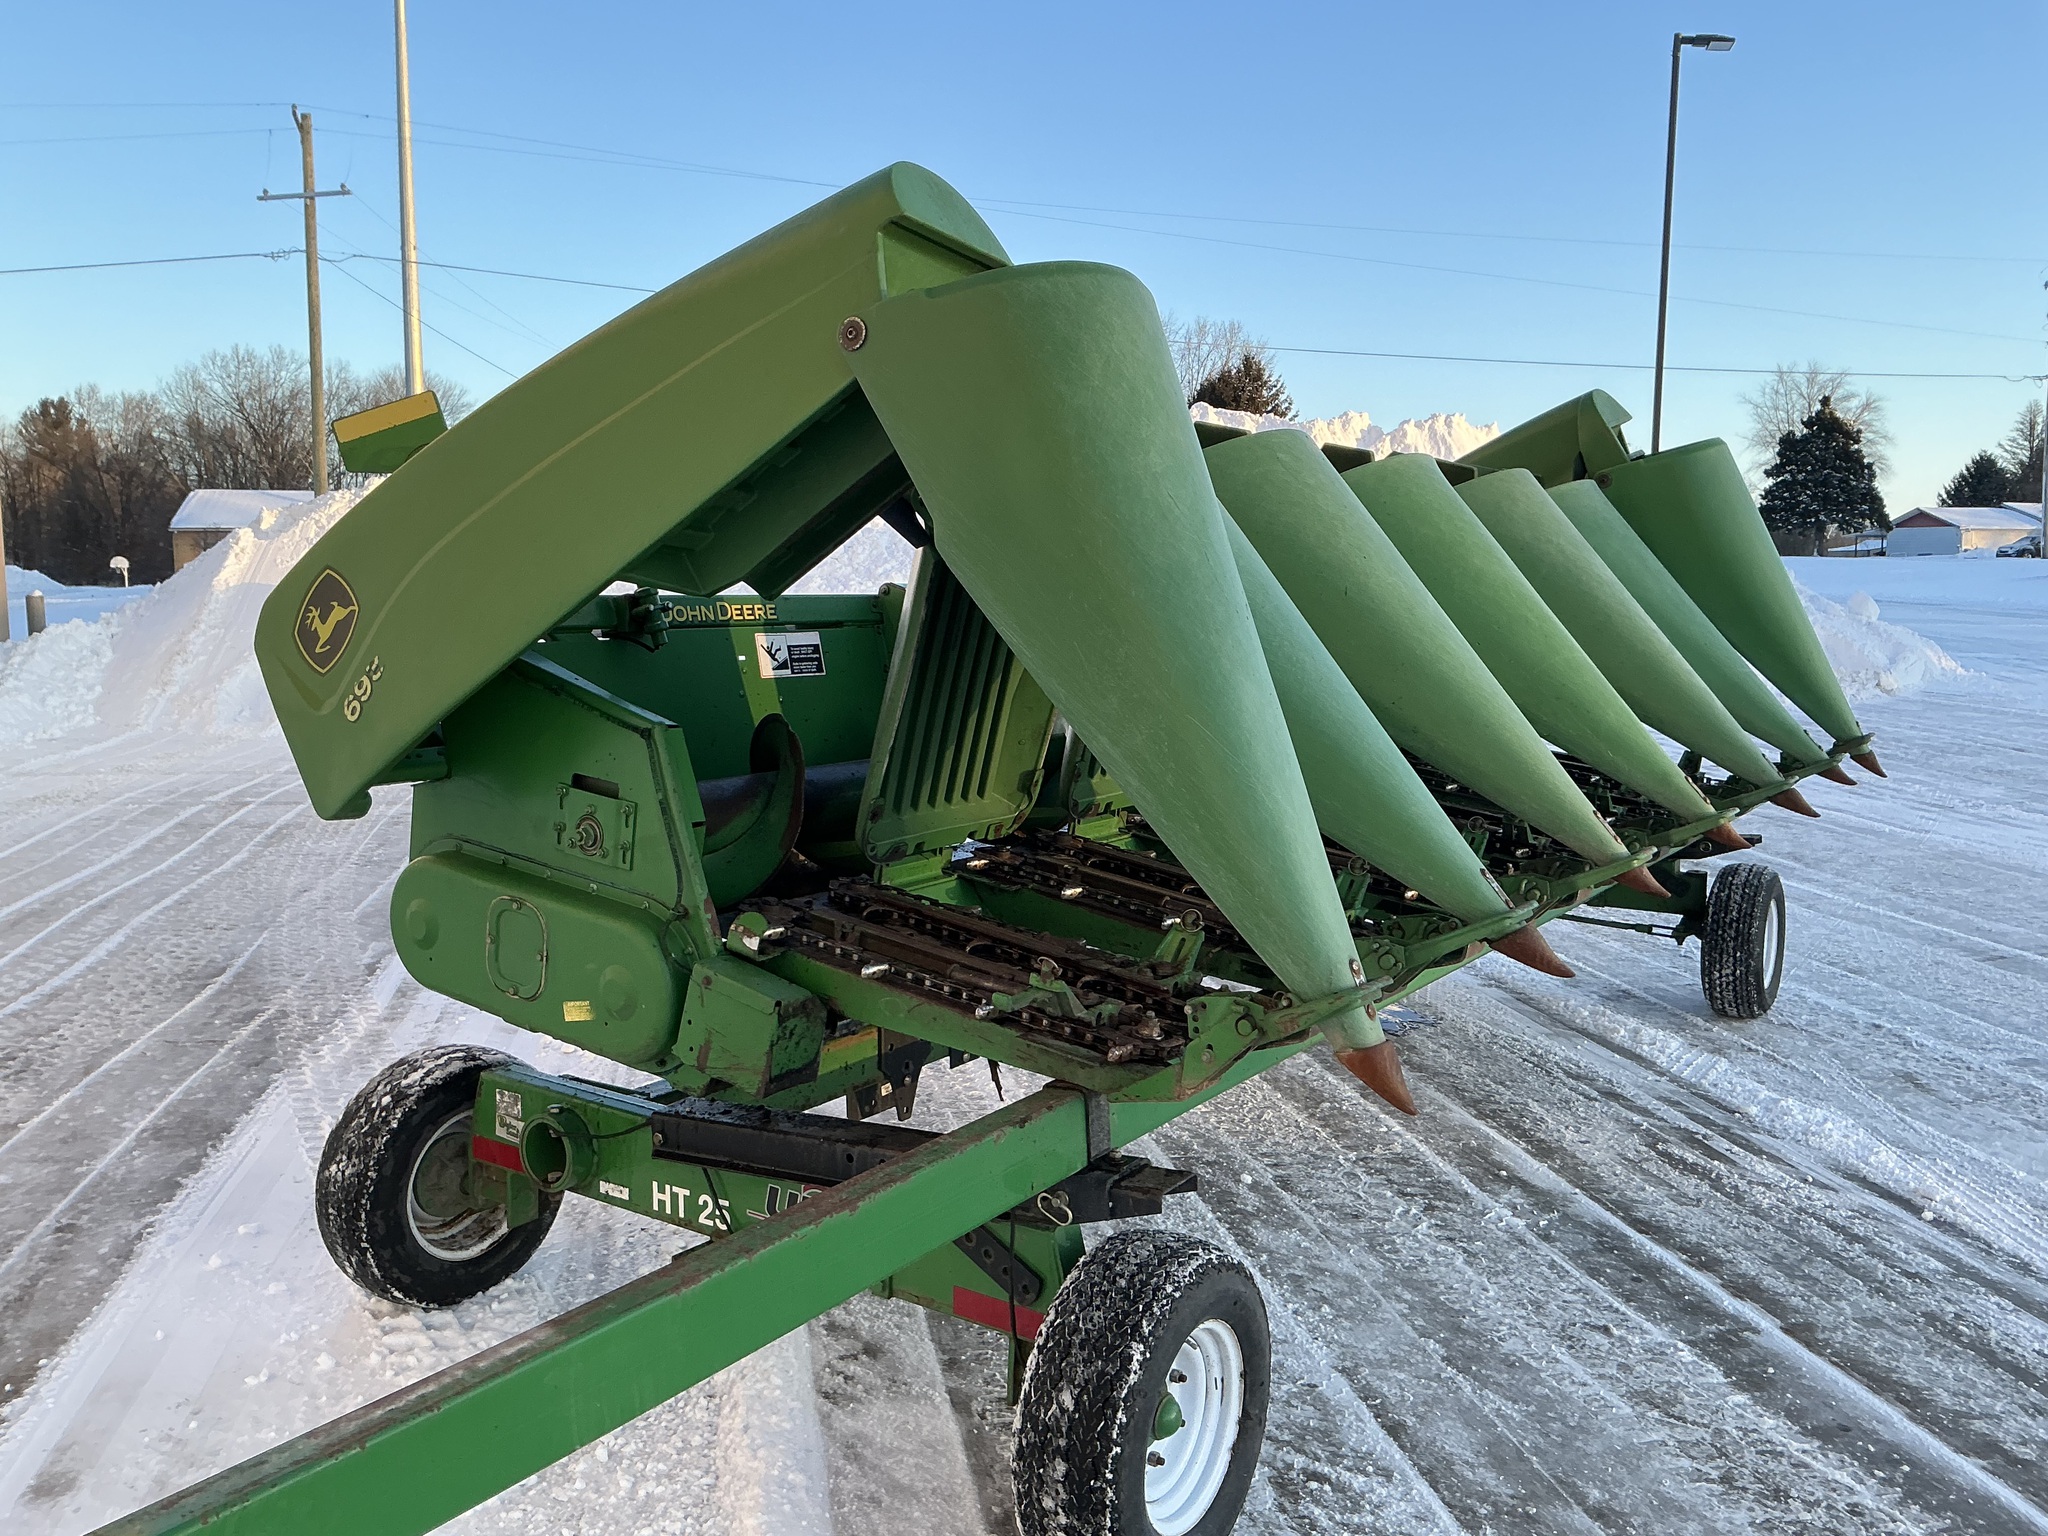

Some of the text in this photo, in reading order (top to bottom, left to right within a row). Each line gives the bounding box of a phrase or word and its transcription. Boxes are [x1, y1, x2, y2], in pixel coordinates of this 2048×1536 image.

[716, 602, 777, 620] DEERE
[652, 1181, 690, 1218] HT
[698, 1194, 731, 1231] 25
